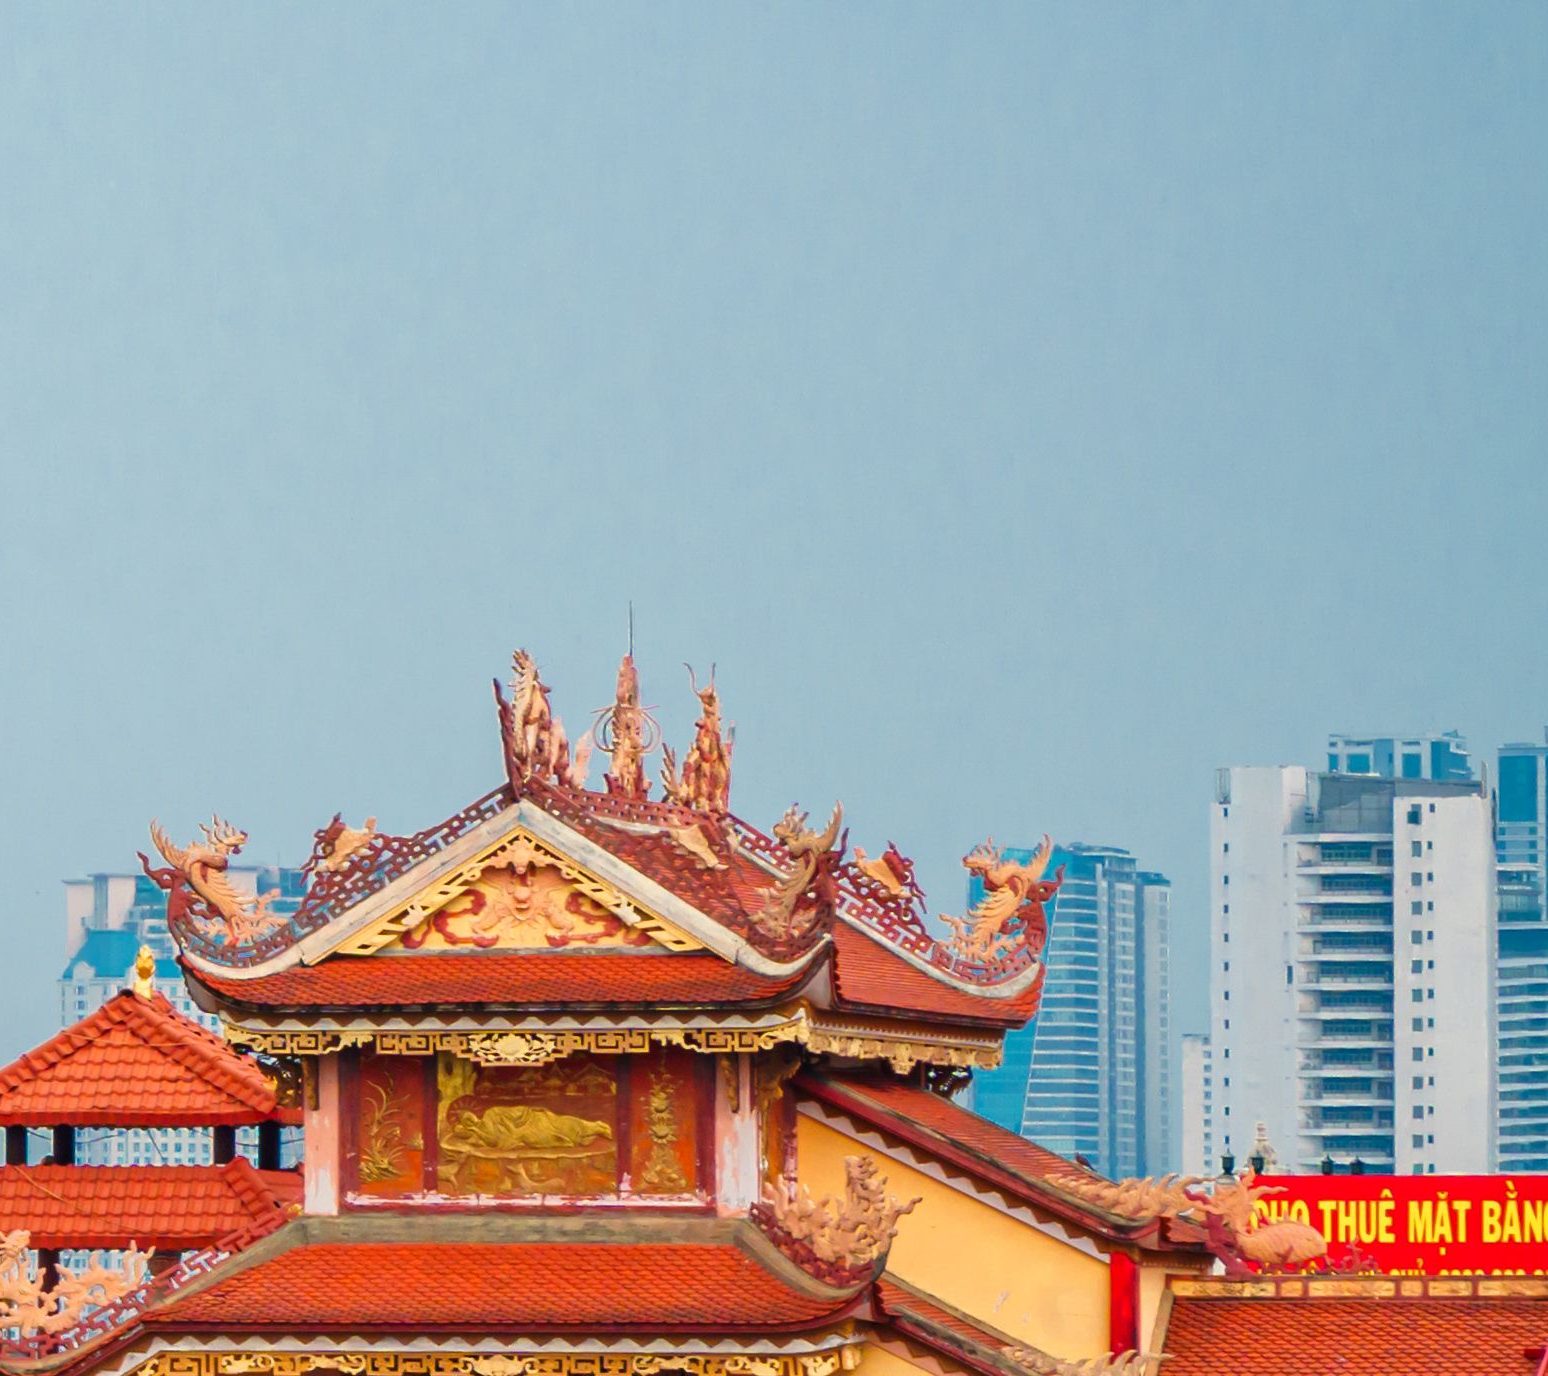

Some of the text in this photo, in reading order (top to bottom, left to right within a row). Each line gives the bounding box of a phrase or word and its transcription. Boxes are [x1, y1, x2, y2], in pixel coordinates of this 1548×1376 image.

[1318, 1188, 1396, 1243] THUÊ
[1408, 1191, 1472, 1256] MẶT
[1482, 1180, 1548, 1243] BẰN
